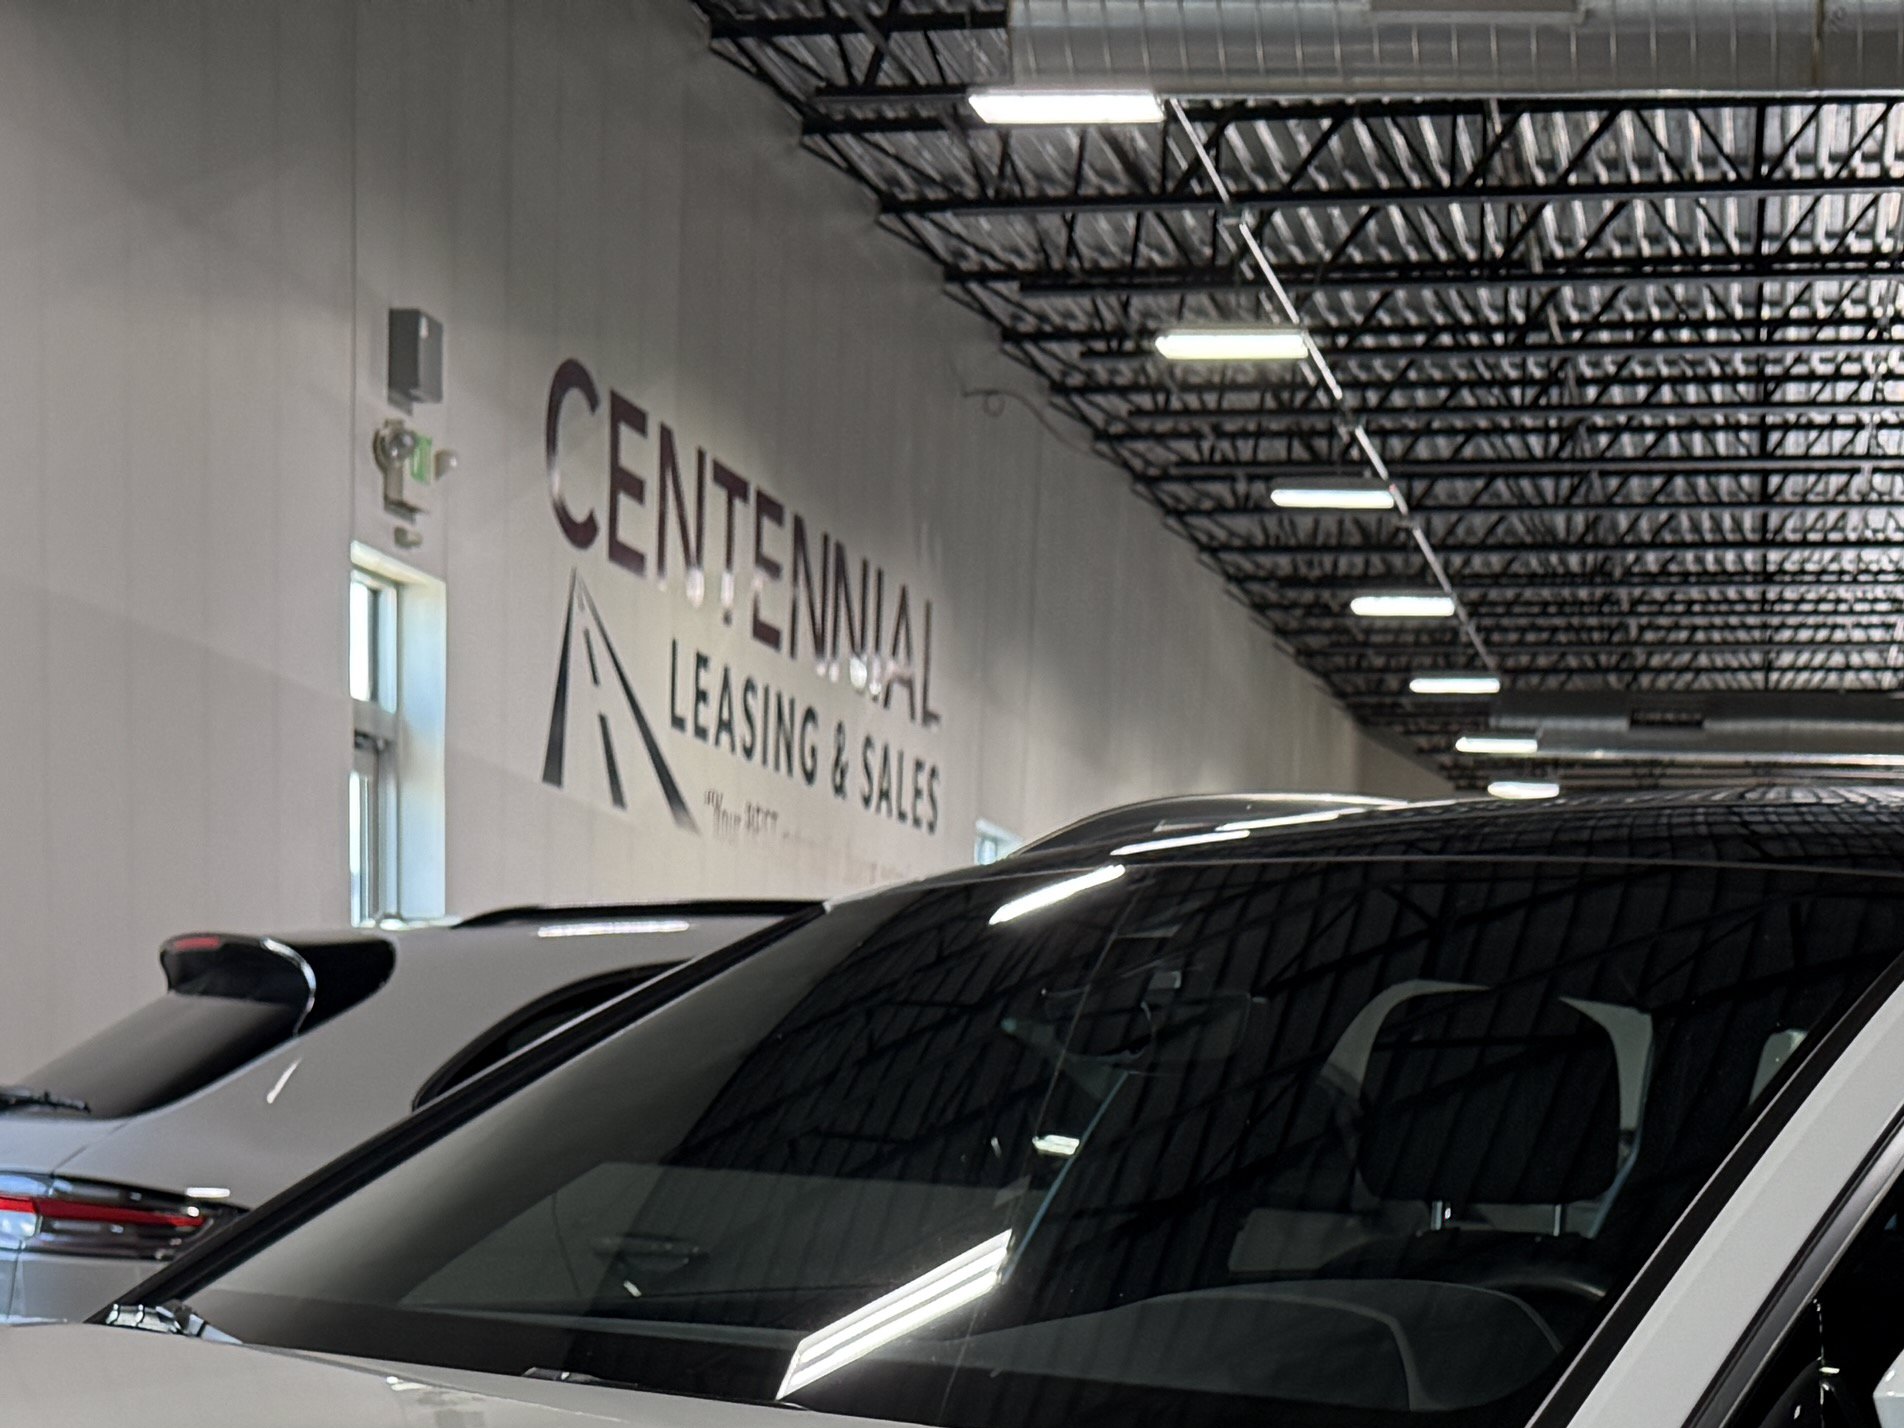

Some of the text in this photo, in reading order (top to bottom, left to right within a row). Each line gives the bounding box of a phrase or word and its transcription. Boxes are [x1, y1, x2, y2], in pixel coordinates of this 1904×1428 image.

[546, 358, 941, 728] CENTENNIAL
[670, 638, 939, 835] LEASING & SALES
